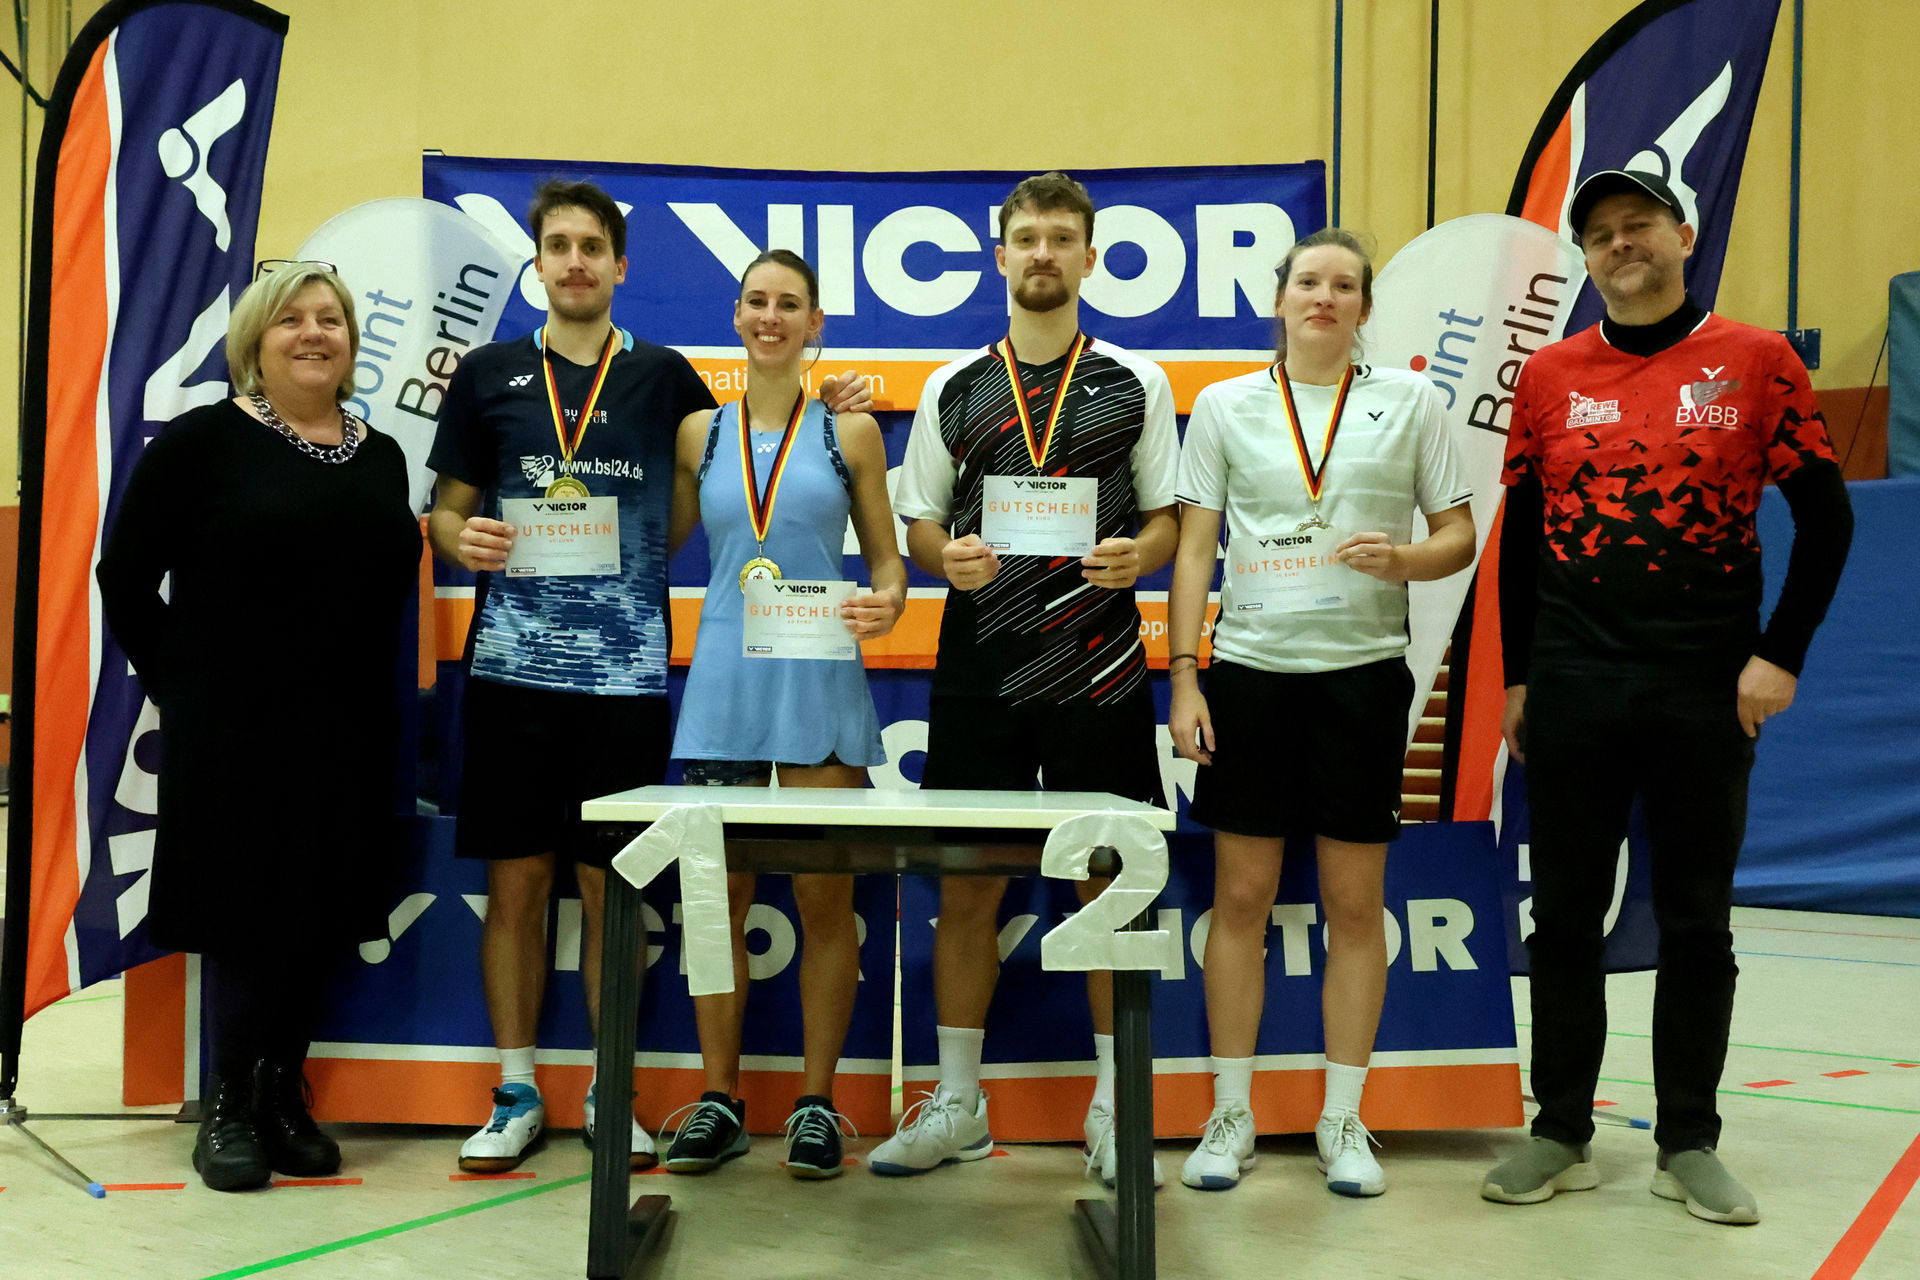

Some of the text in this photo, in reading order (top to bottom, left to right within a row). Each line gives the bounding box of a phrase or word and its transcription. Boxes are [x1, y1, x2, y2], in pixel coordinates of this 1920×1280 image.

[667, 202, 1295, 317] VICOR
[395, 263, 498, 422] Berlin
[1467, 273, 1568, 436] Berlin
[1569, 414, 1618, 426] BADMINTON
[1676, 405, 1738, 426] BVBB
[1027, 481, 1067, 490] VICTOR
[546, 502, 587, 511] VICTOR
[988, 501, 1090, 514] GUTSCHEIN
[1272, 535, 1312, 546] VICTOR
[1237, 554, 1338, 575] GUTSCHEIN
[788, 585, 827, 594] VICTOR
[749, 605, 837, 618] GUTSCHEI
[612, 803, 735, 996] 1
[1041, 812, 1170, 971] 2
